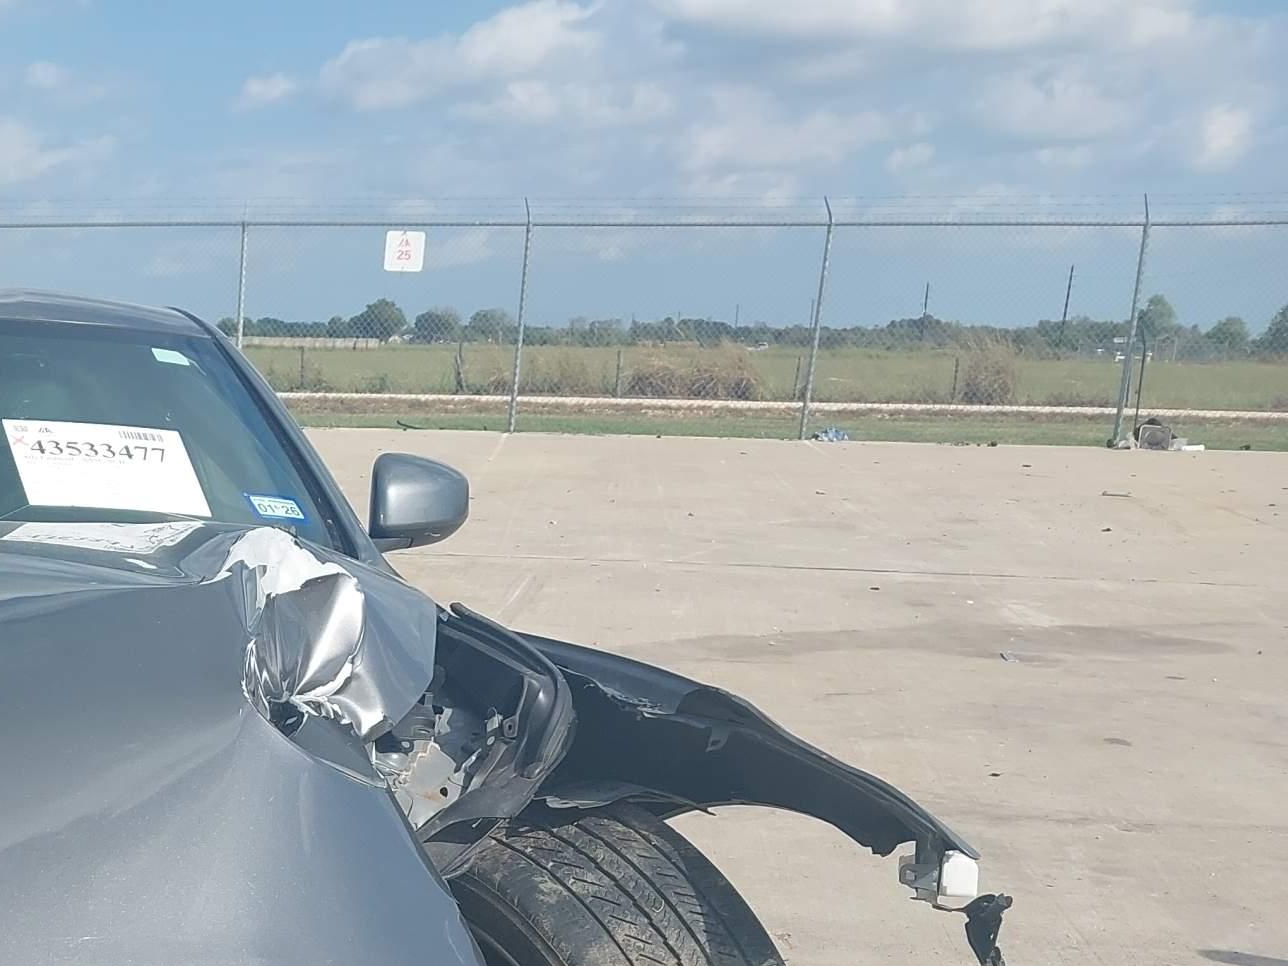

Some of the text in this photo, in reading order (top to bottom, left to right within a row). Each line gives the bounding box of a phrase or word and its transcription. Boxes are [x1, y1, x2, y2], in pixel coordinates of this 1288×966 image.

[396, 249, 411, 260] 25
[30, 440, 165, 463] 43533477
[281, 505, 301, 517] 26
